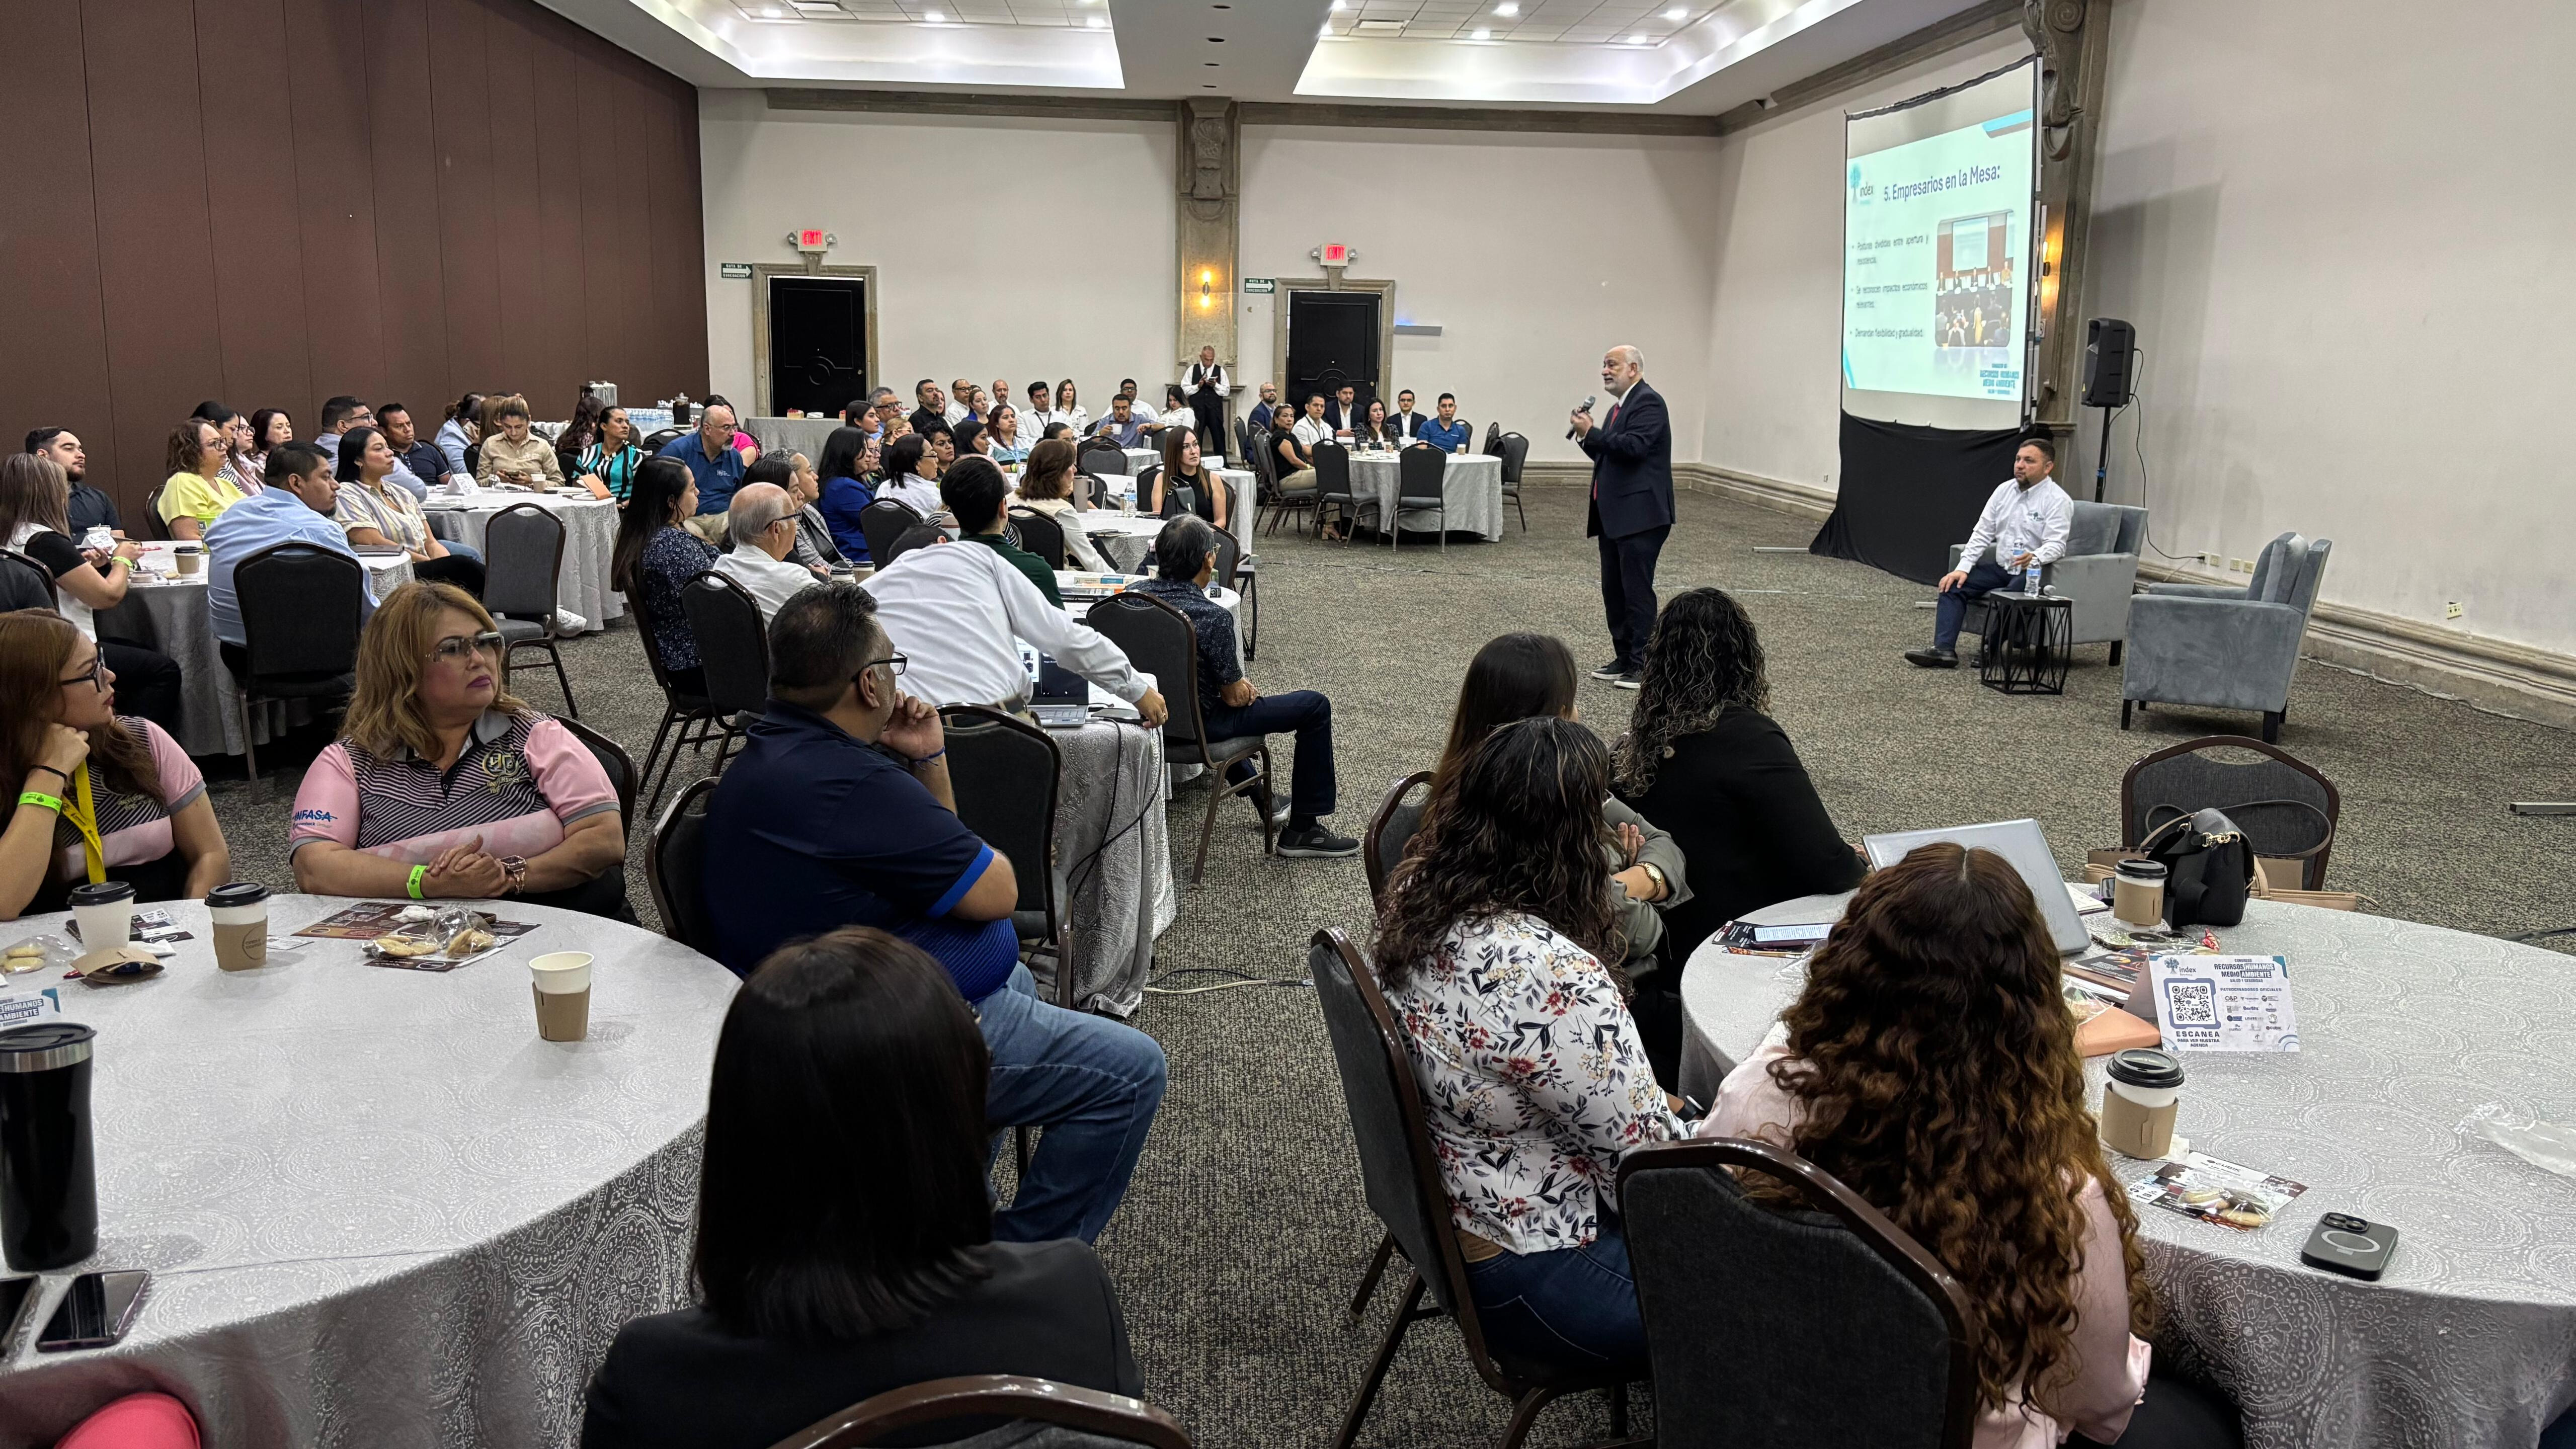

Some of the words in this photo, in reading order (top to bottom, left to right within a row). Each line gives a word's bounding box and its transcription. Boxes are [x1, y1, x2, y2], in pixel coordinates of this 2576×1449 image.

[1893, 176, 1943, 202] Empresarios
[1946, 175, 1956, 189] en
[1959, 170, 1967, 187] la
[1970, 165, 2000, 185] Mesa:
[802, 230, 822, 245] EXIT
[4, 999, 43, 1011] HUMANOS
